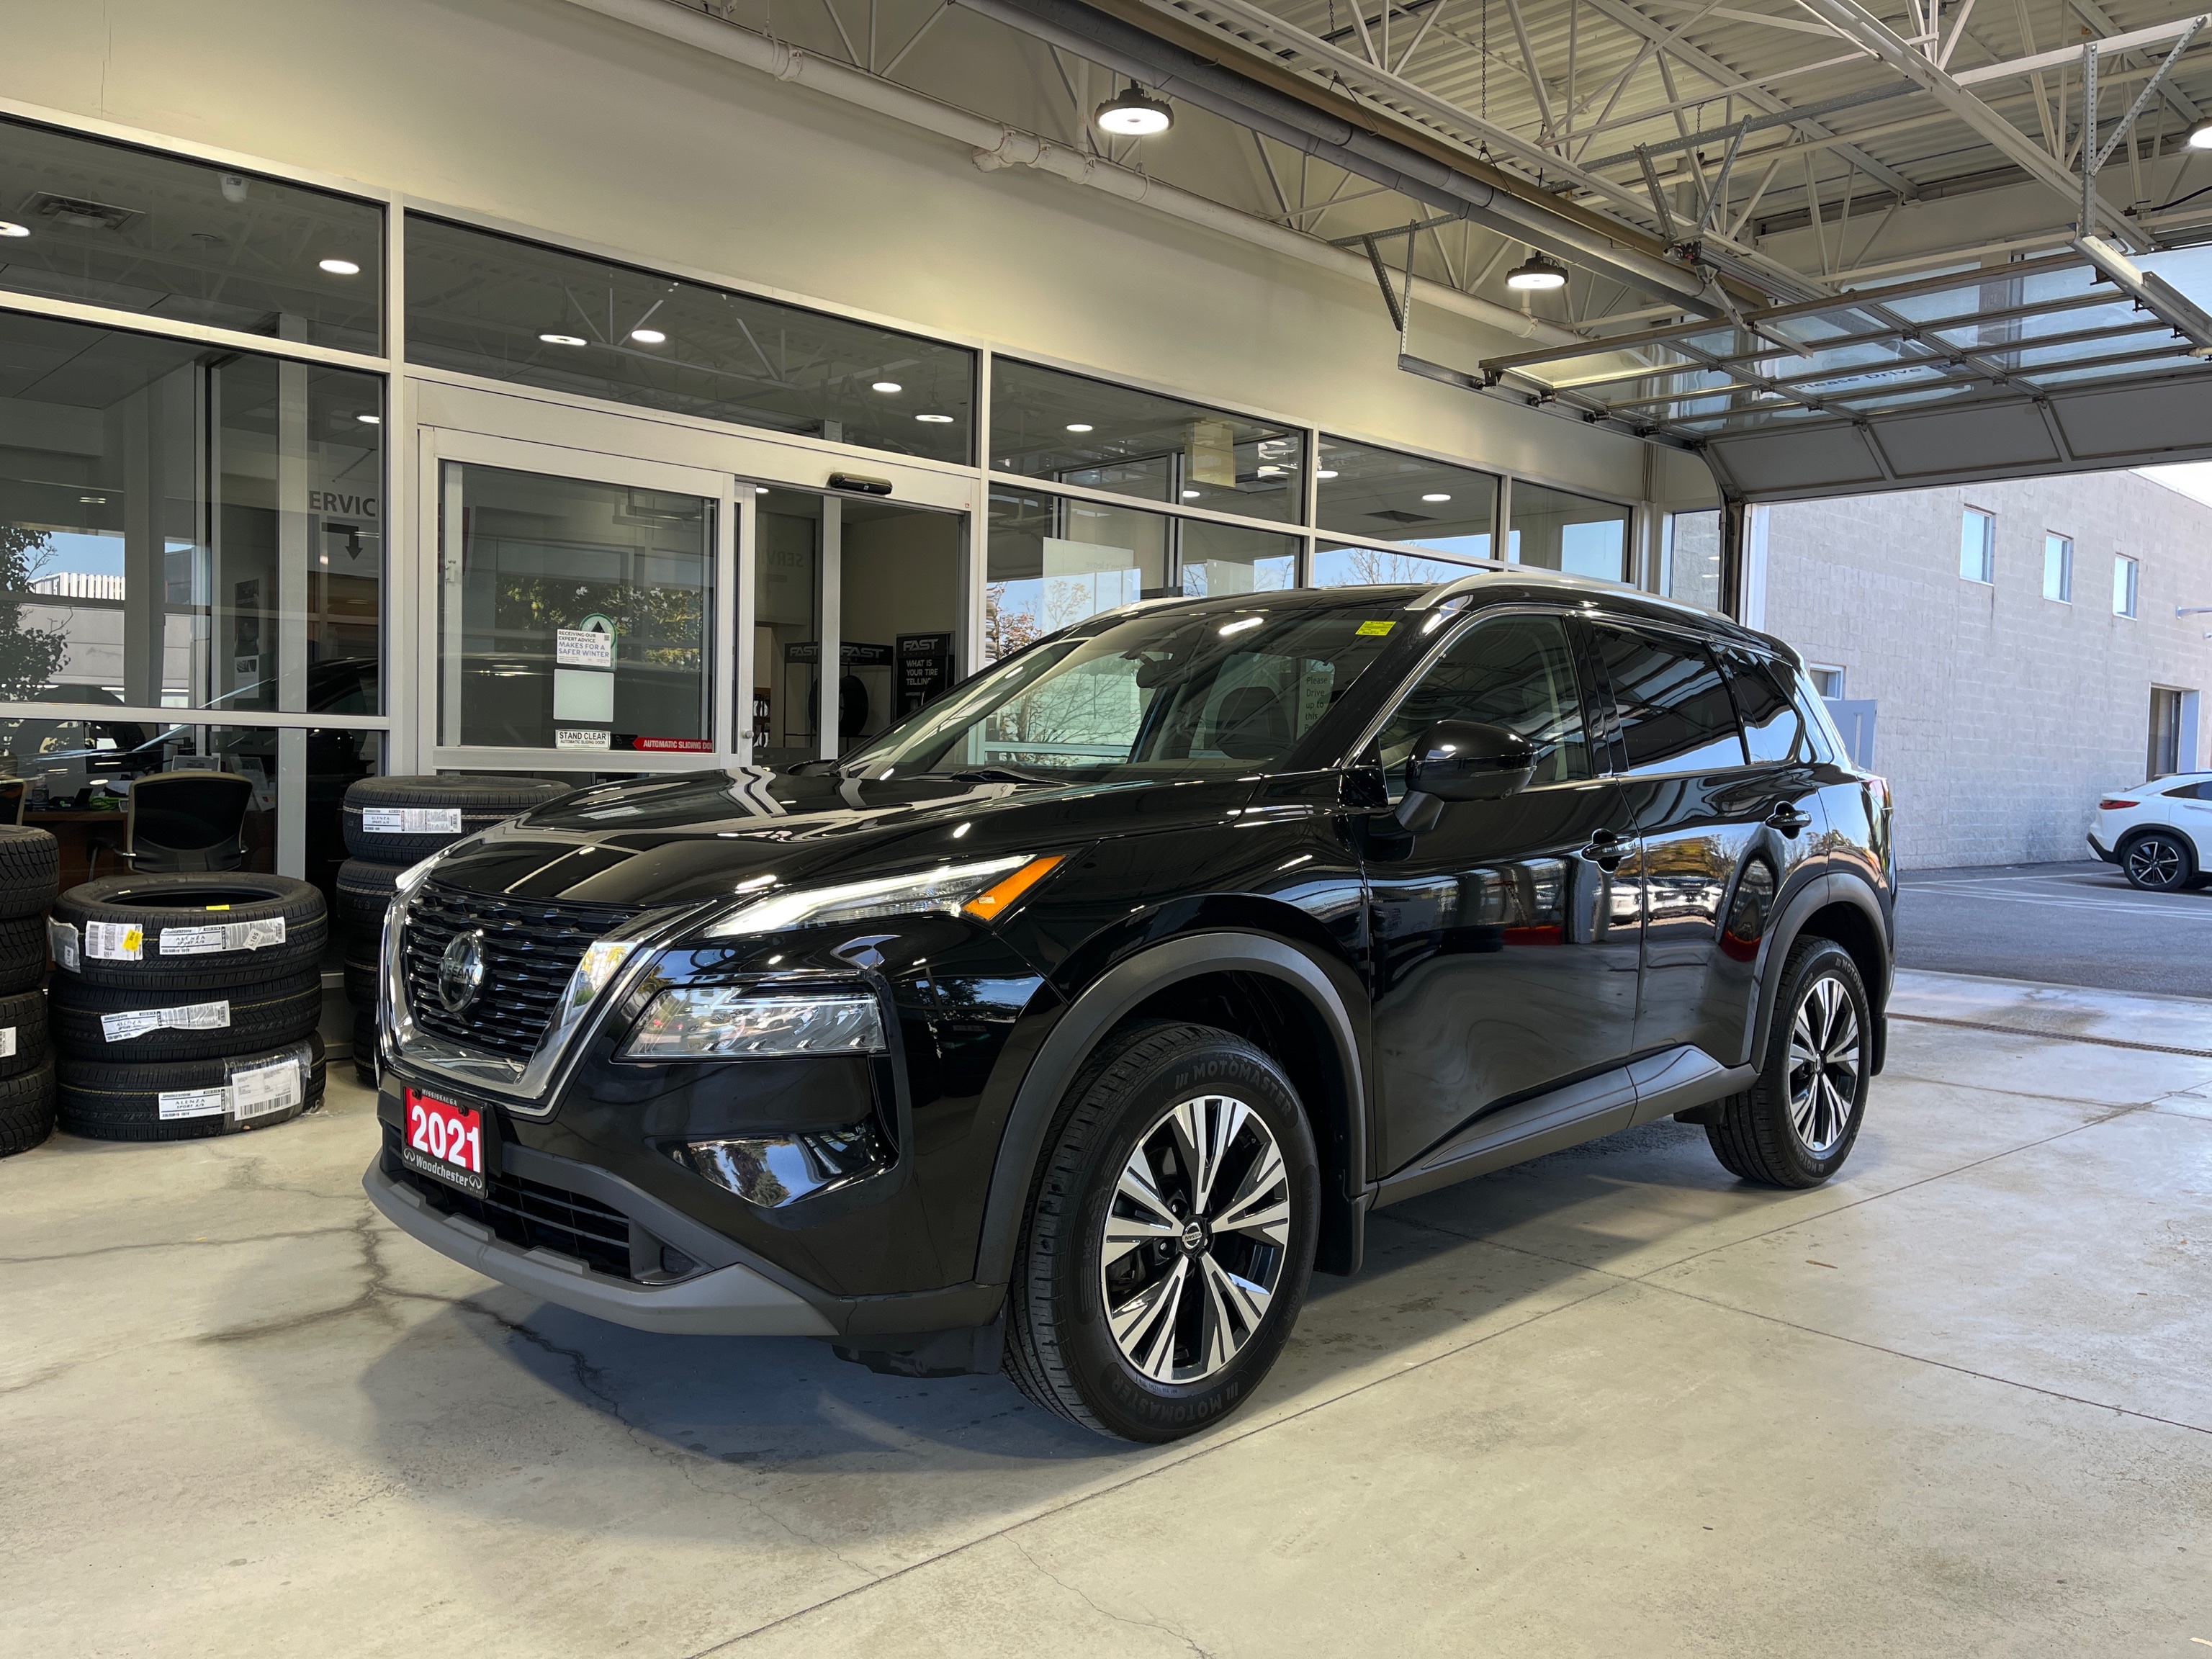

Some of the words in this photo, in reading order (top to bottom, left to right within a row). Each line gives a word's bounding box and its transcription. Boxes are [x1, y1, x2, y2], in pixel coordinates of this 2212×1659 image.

[1794, 377, 1860, 390] Please
[1865, 367, 1922, 379] Drive
[309, 490, 379, 517] ERVIC
[903, 639, 938, 652] FAST
[1306, 676, 1328, 685] Please
[1306, 688, 1325, 697] Drive
[1305, 712, 1318, 721] this
[643, 739, 677, 749] AUTOMATIC
[678, 741, 701, 750] SLIDING
[421, 1088, 457, 1107] MISSISSAUGA
[1193, 1060, 1292, 1116] MOTOMASTER
[411, 1105, 480, 1173] 2021
[416, 1154, 469, 1187] Woodchester
[1111, 1374, 1223, 1423] MOTOMASTER
